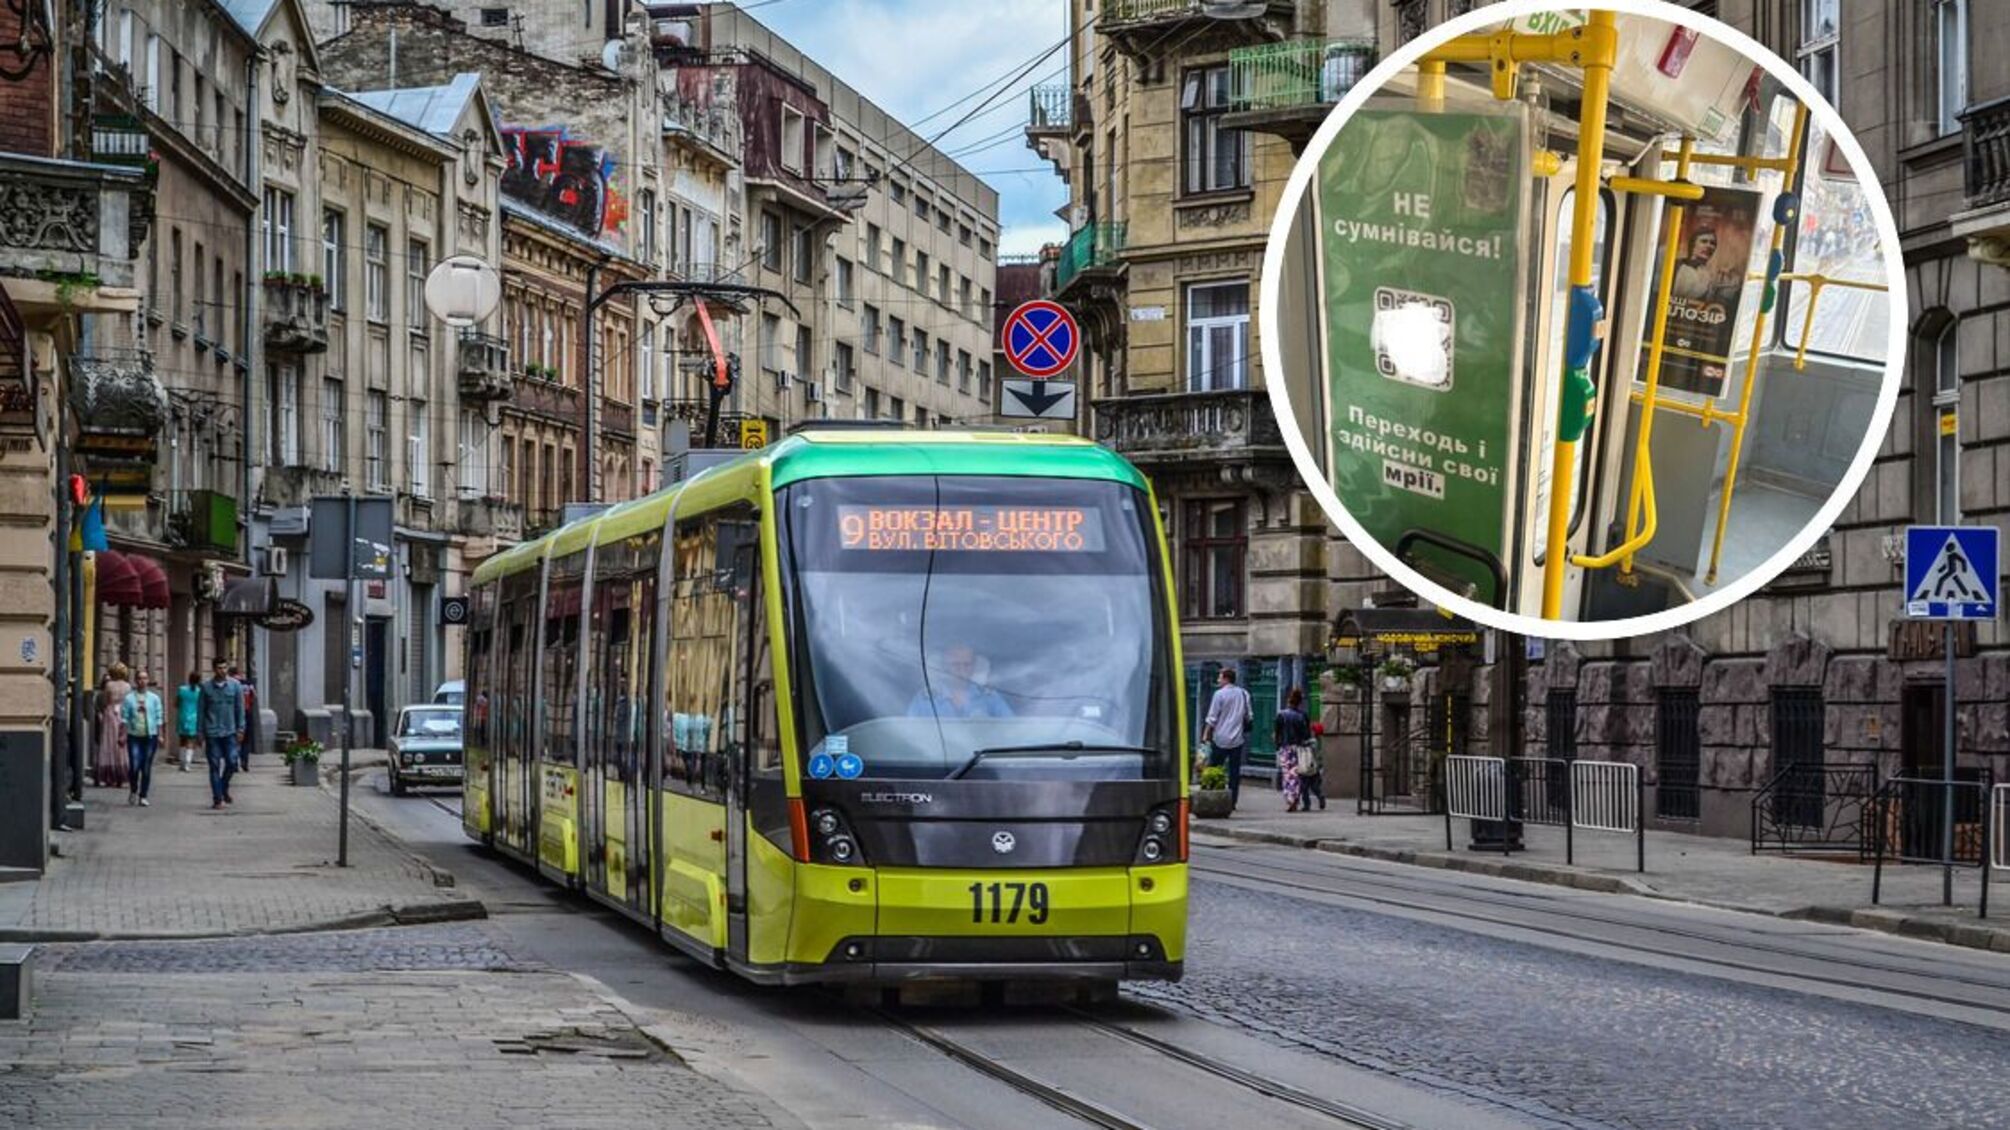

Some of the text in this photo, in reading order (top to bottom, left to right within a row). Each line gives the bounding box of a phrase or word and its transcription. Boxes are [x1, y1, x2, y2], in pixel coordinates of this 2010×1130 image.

[1393, 191, 1430, 218] НЕ
[1334, 218, 1501, 259] сумнівайся!
[1348, 404, 1487, 459] Переходь і
[1338, 429, 1499, 486] здійсни свої
[1385, 466, 1442, 494] мрії.
[841, 513, 864, 546] 9
[868, 509, 973, 531] ВОКЗАЛ
[998, 509, 1083, 533] ЦЕНТР
[868, 532, 1083, 550] ВУЛ. ВІТОВСЬКОГО
[860, 792, 933, 804] ELECTRON
[969, 881, 1049, 925] 1179
